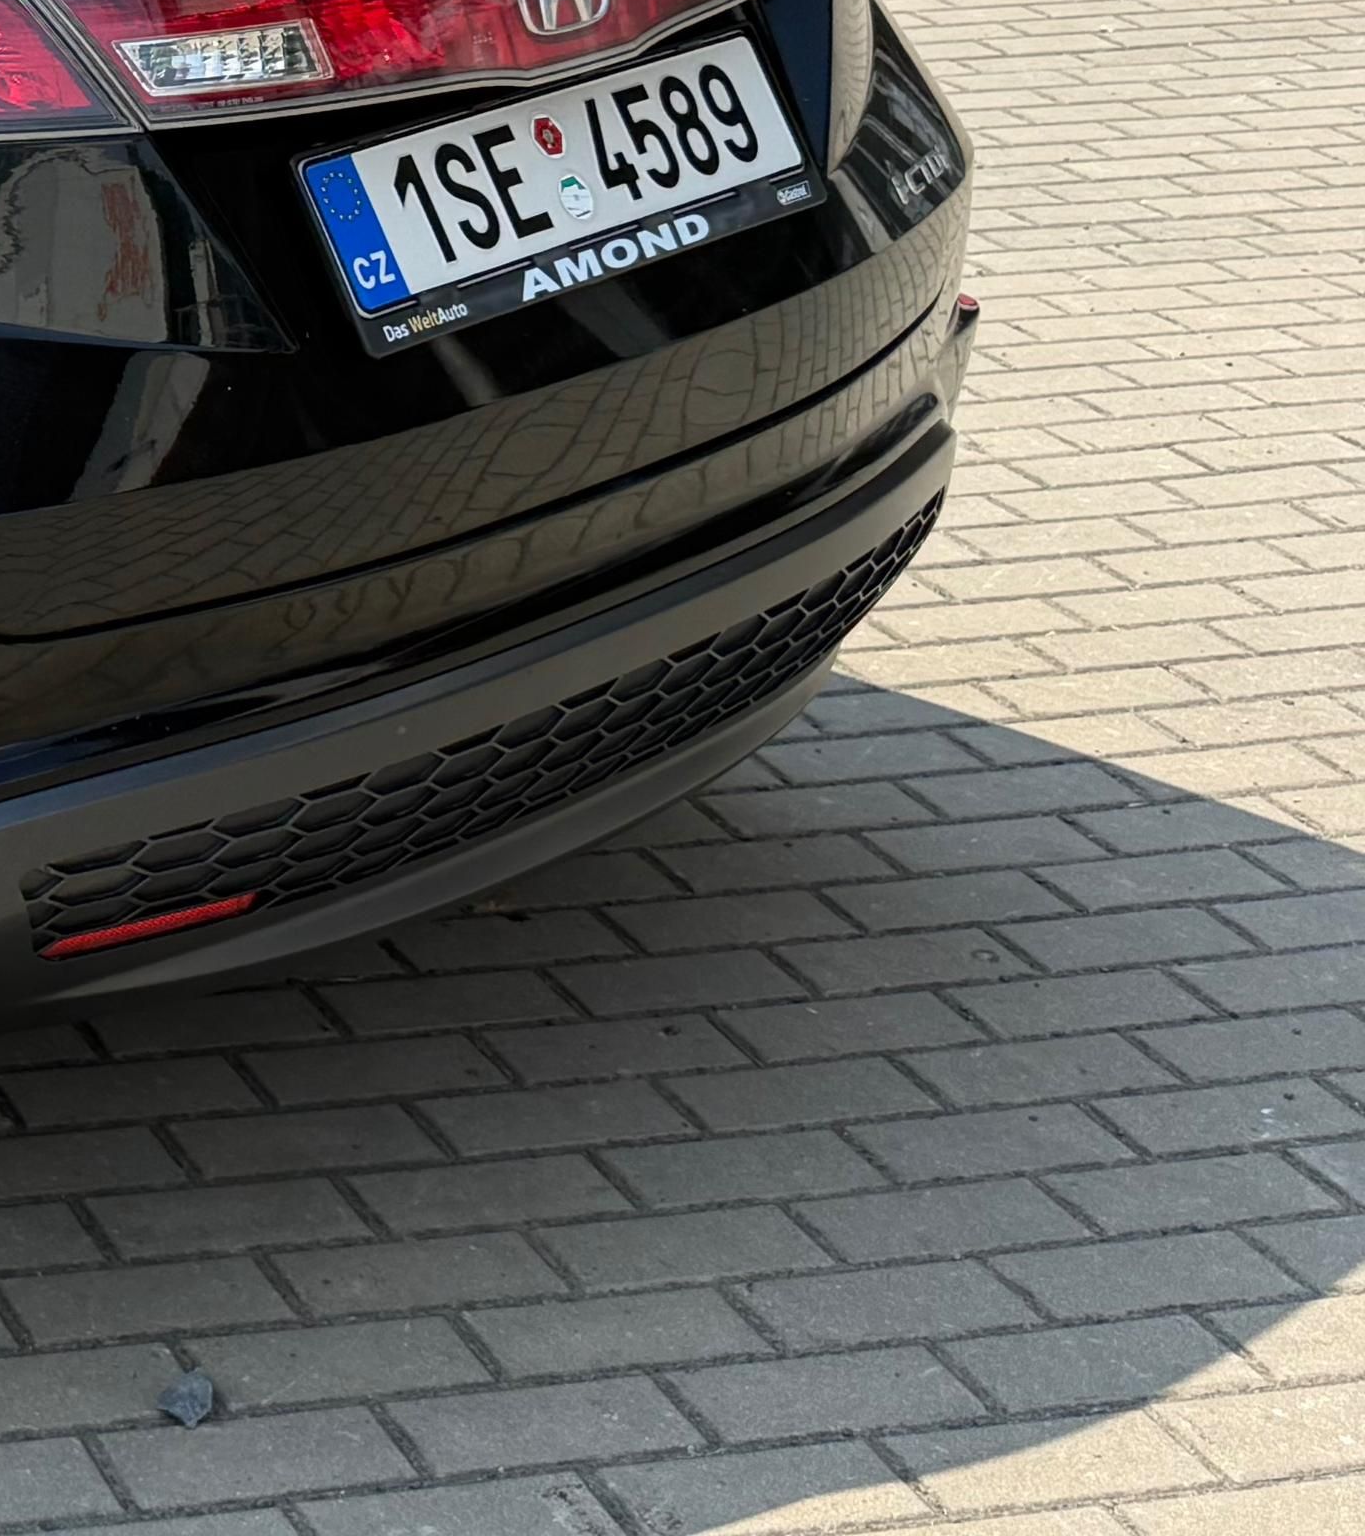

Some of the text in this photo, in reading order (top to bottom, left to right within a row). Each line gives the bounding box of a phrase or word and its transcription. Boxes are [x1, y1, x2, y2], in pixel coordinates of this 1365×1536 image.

[393, 64, 759, 263] 1SE 4589
[353, 250, 396, 290] CZ
[521, 214, 710, 302] AMOND
[382, 302, 469, 342] Das WeltAuto
